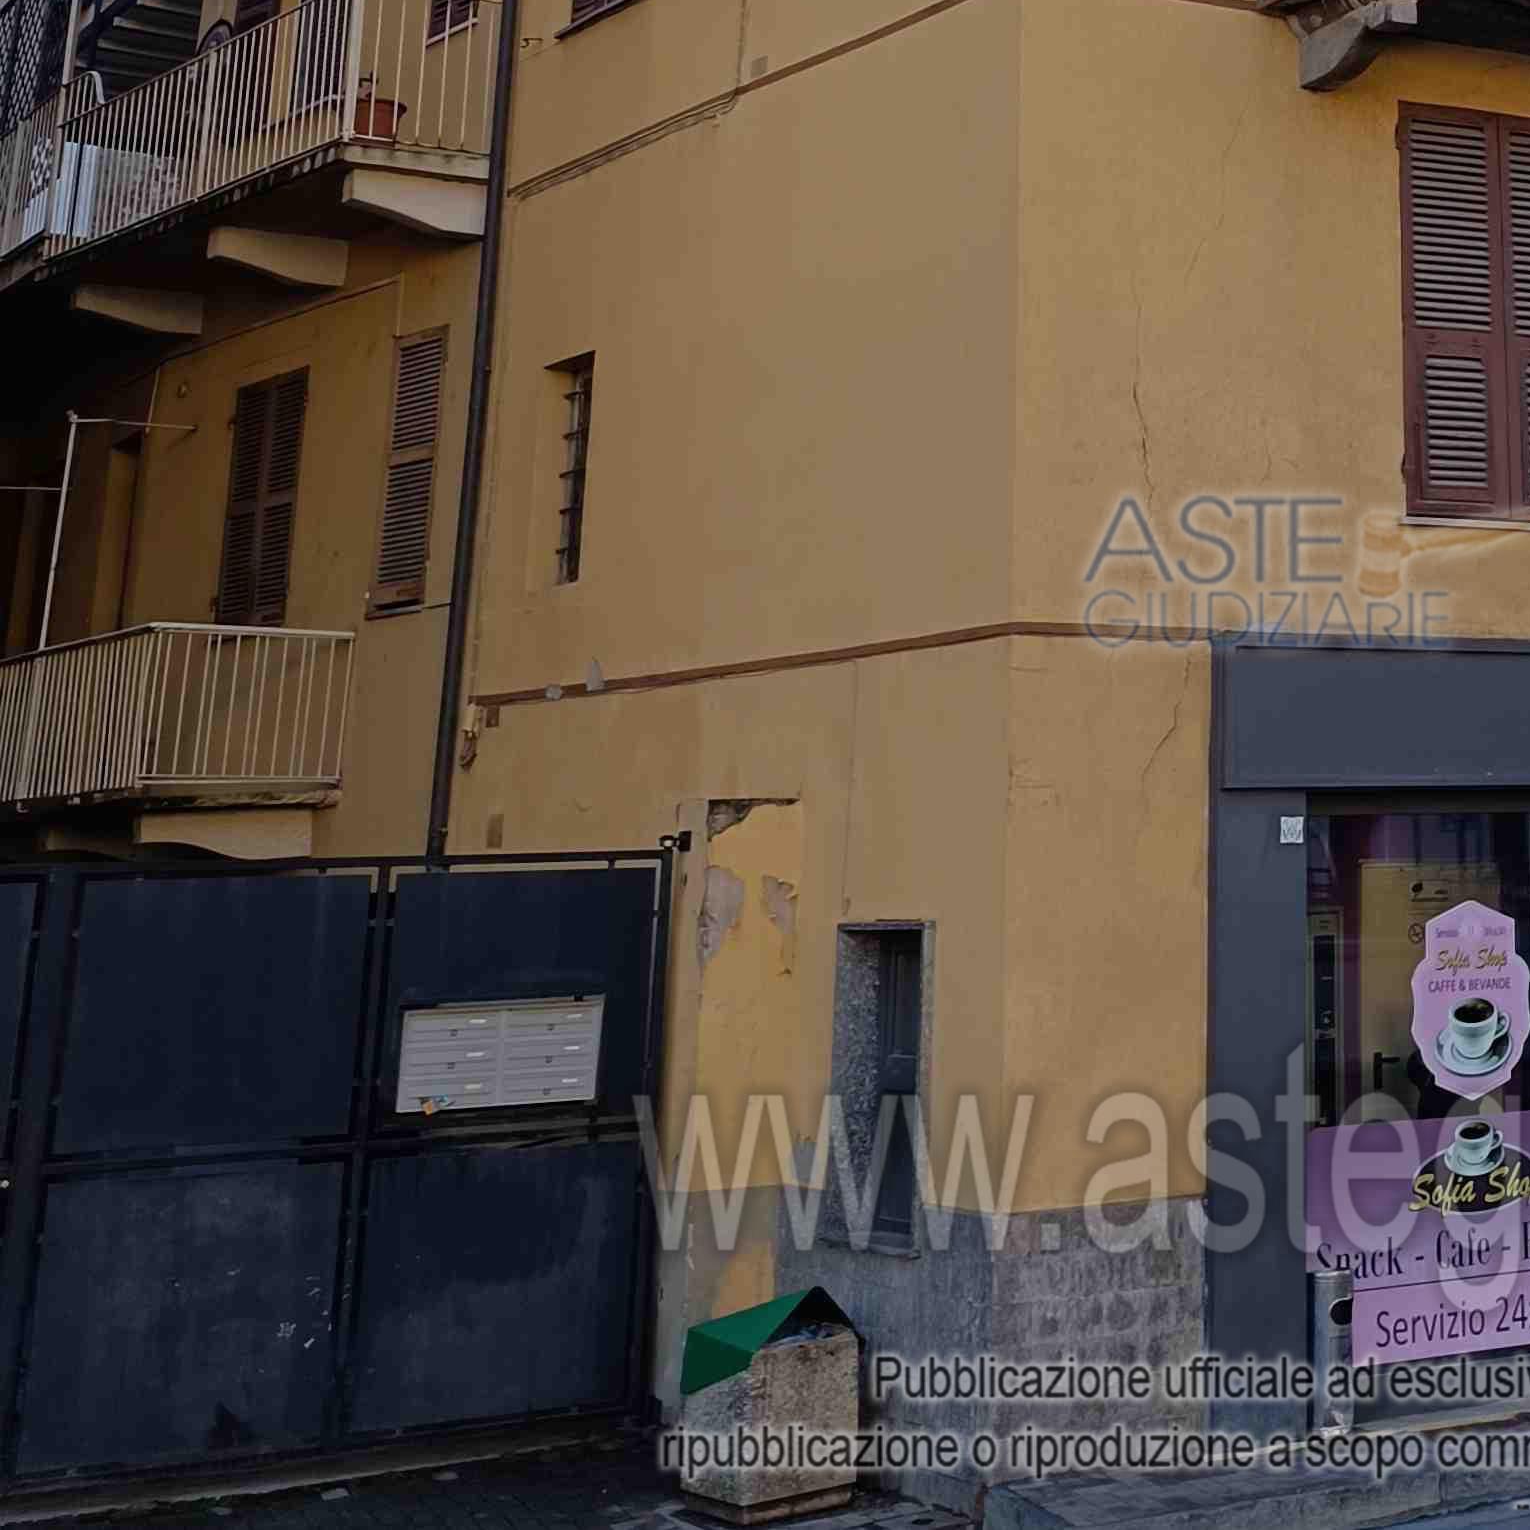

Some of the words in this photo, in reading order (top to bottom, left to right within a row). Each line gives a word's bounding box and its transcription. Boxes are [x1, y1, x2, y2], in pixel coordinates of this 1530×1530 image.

[1468, 976, 1512, 990] BEVANDE
[1408, 1173, 1477, 1217] Sofia
[1375, 1300, 1486, 1348] Servizio
